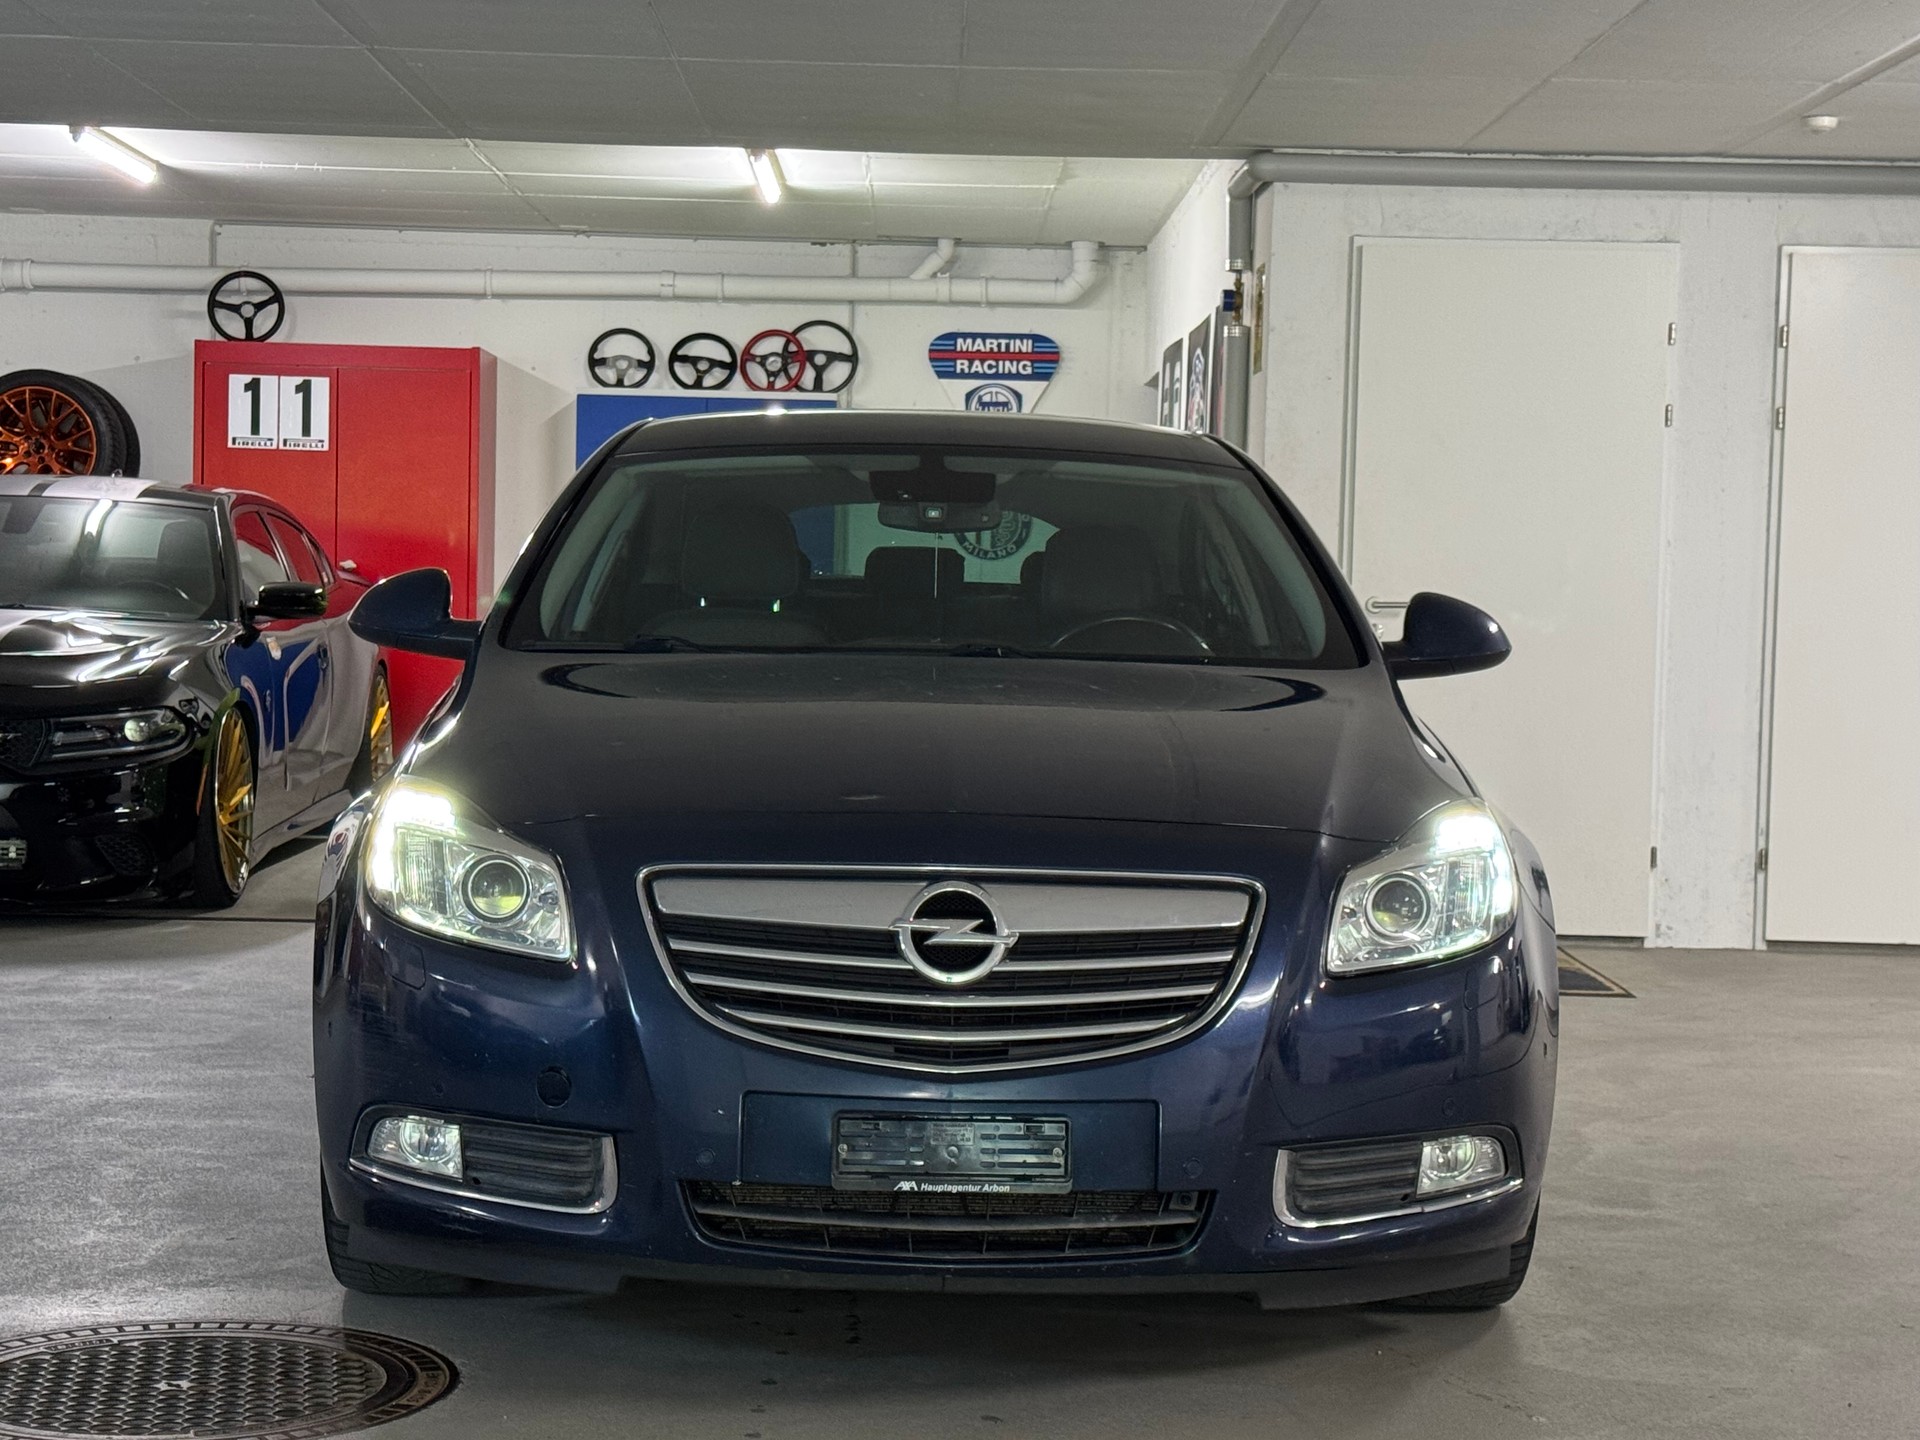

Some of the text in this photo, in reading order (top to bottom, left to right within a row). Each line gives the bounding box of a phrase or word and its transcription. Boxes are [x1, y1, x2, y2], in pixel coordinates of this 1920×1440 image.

[956, 338, 1033, 353] MARTINI
[956, 359, 1033, 375] RACING
[243, 377, 312, 438] 1 1
[962, 542, 1016, 559] MILANO
[894, 1181, 1010, 1193] AXA Hauptagentur Arbon
